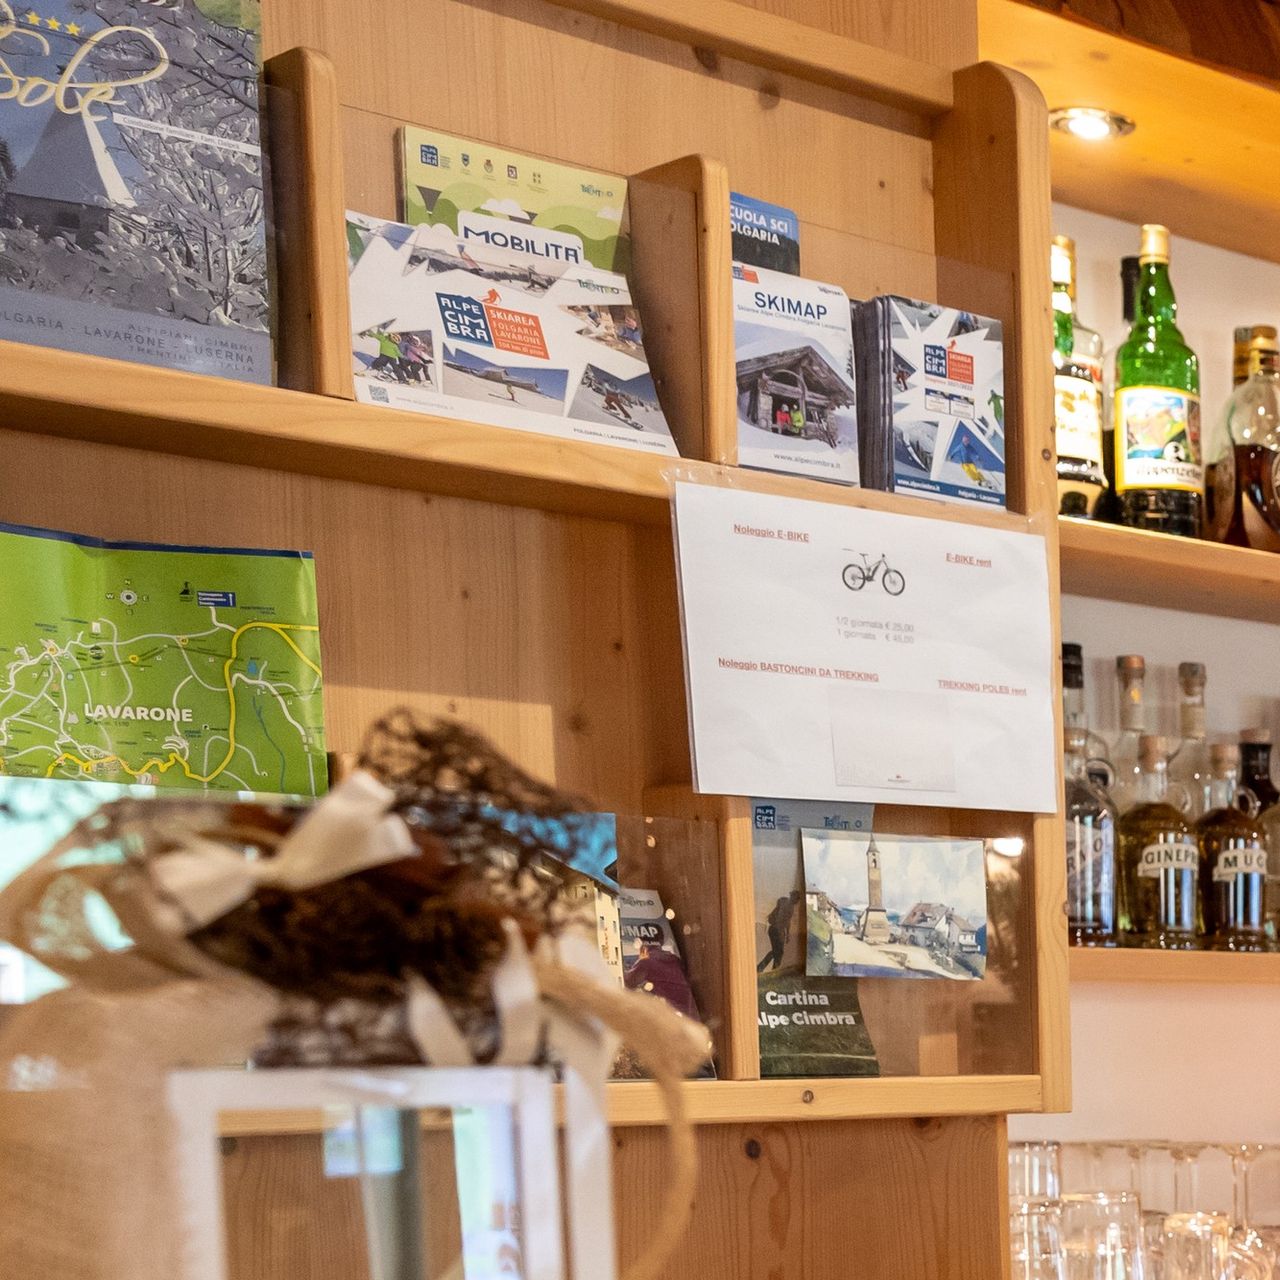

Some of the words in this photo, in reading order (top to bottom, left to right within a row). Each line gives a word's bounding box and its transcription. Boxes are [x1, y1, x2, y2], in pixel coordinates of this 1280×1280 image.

[770, 219, 788, 233] SCI
[441, 297, 481, 314] ALPE
[490, 309, 536, 327] SKIAREA
[754, 291, 827, 320] SKIMAP
[445, 310, 485, 329] CIM
[493, 321, 540, 338] FOLGARIA
[447, 322, 489, 342] BRA
[84, 325, 165, 350] LAVARONE
[129, 346, 188, 362] TRENTIN
[734, 523, 775, 539] Noleggio
[777, 529, 810, 543] E-BIKE
[946, 552, 974, 566] E-BIKE
[976, 557, 992, 567] rent
[718, 657, 758, 672] Noleggio
[760, 661, 817, 678] BASTONCINI
[819, 668, 832, 679] DA
[834, 669, 879, 683] TREKKING
[938, 679, 980, 693] TREKKING
[982, 683, 1010, 695] POLES
[1011, 686, 1027, 697] rent
[84, 703, 193, 723] LAVARONE
[765, 990, 830, 1006] Cartina
[791, 1010, 856, 1025] Cimbra
